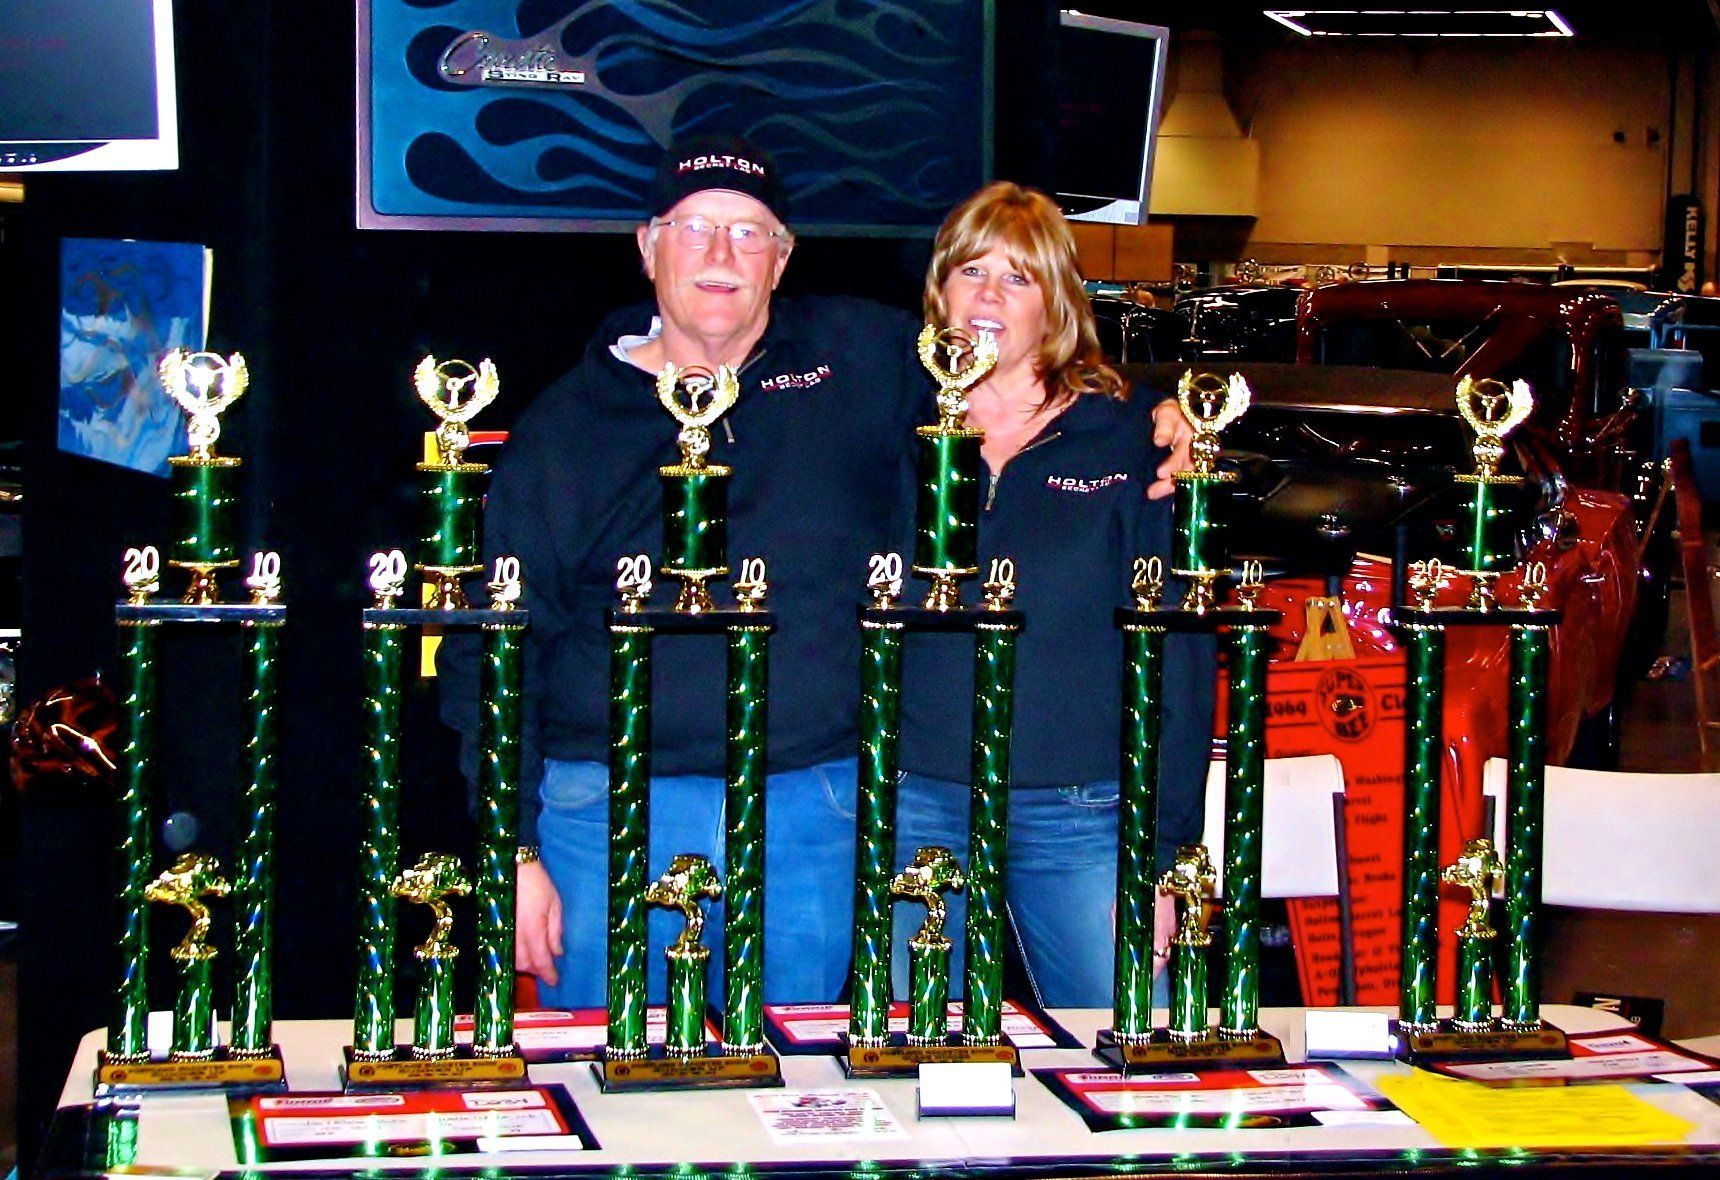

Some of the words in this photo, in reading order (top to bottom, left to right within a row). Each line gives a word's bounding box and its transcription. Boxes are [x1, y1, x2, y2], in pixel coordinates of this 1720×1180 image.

[679, 155, 765, 175] HOLTON
[1684, 206, 1698, 259] KELLY
[760, 365, 831, 389] HOLTON
[1047, 473, 1128, 488] HOLTON
[124, 546, 160, 580] 20
[253, 551, 281, 578] 10
[370, 550, 408, 583] 20
[493, 556, 520, 582] 10
[616, 554, 652, 588] 20
[739, 557, 766, 586] 10
[868, 552, 903, 587] 20
[988, 557, 1015, 586] 10
[1132, 556, 1162, 587] 20
[1240, 559, 1263, 586] 10
[1523, 560, 1547, 586] 10
